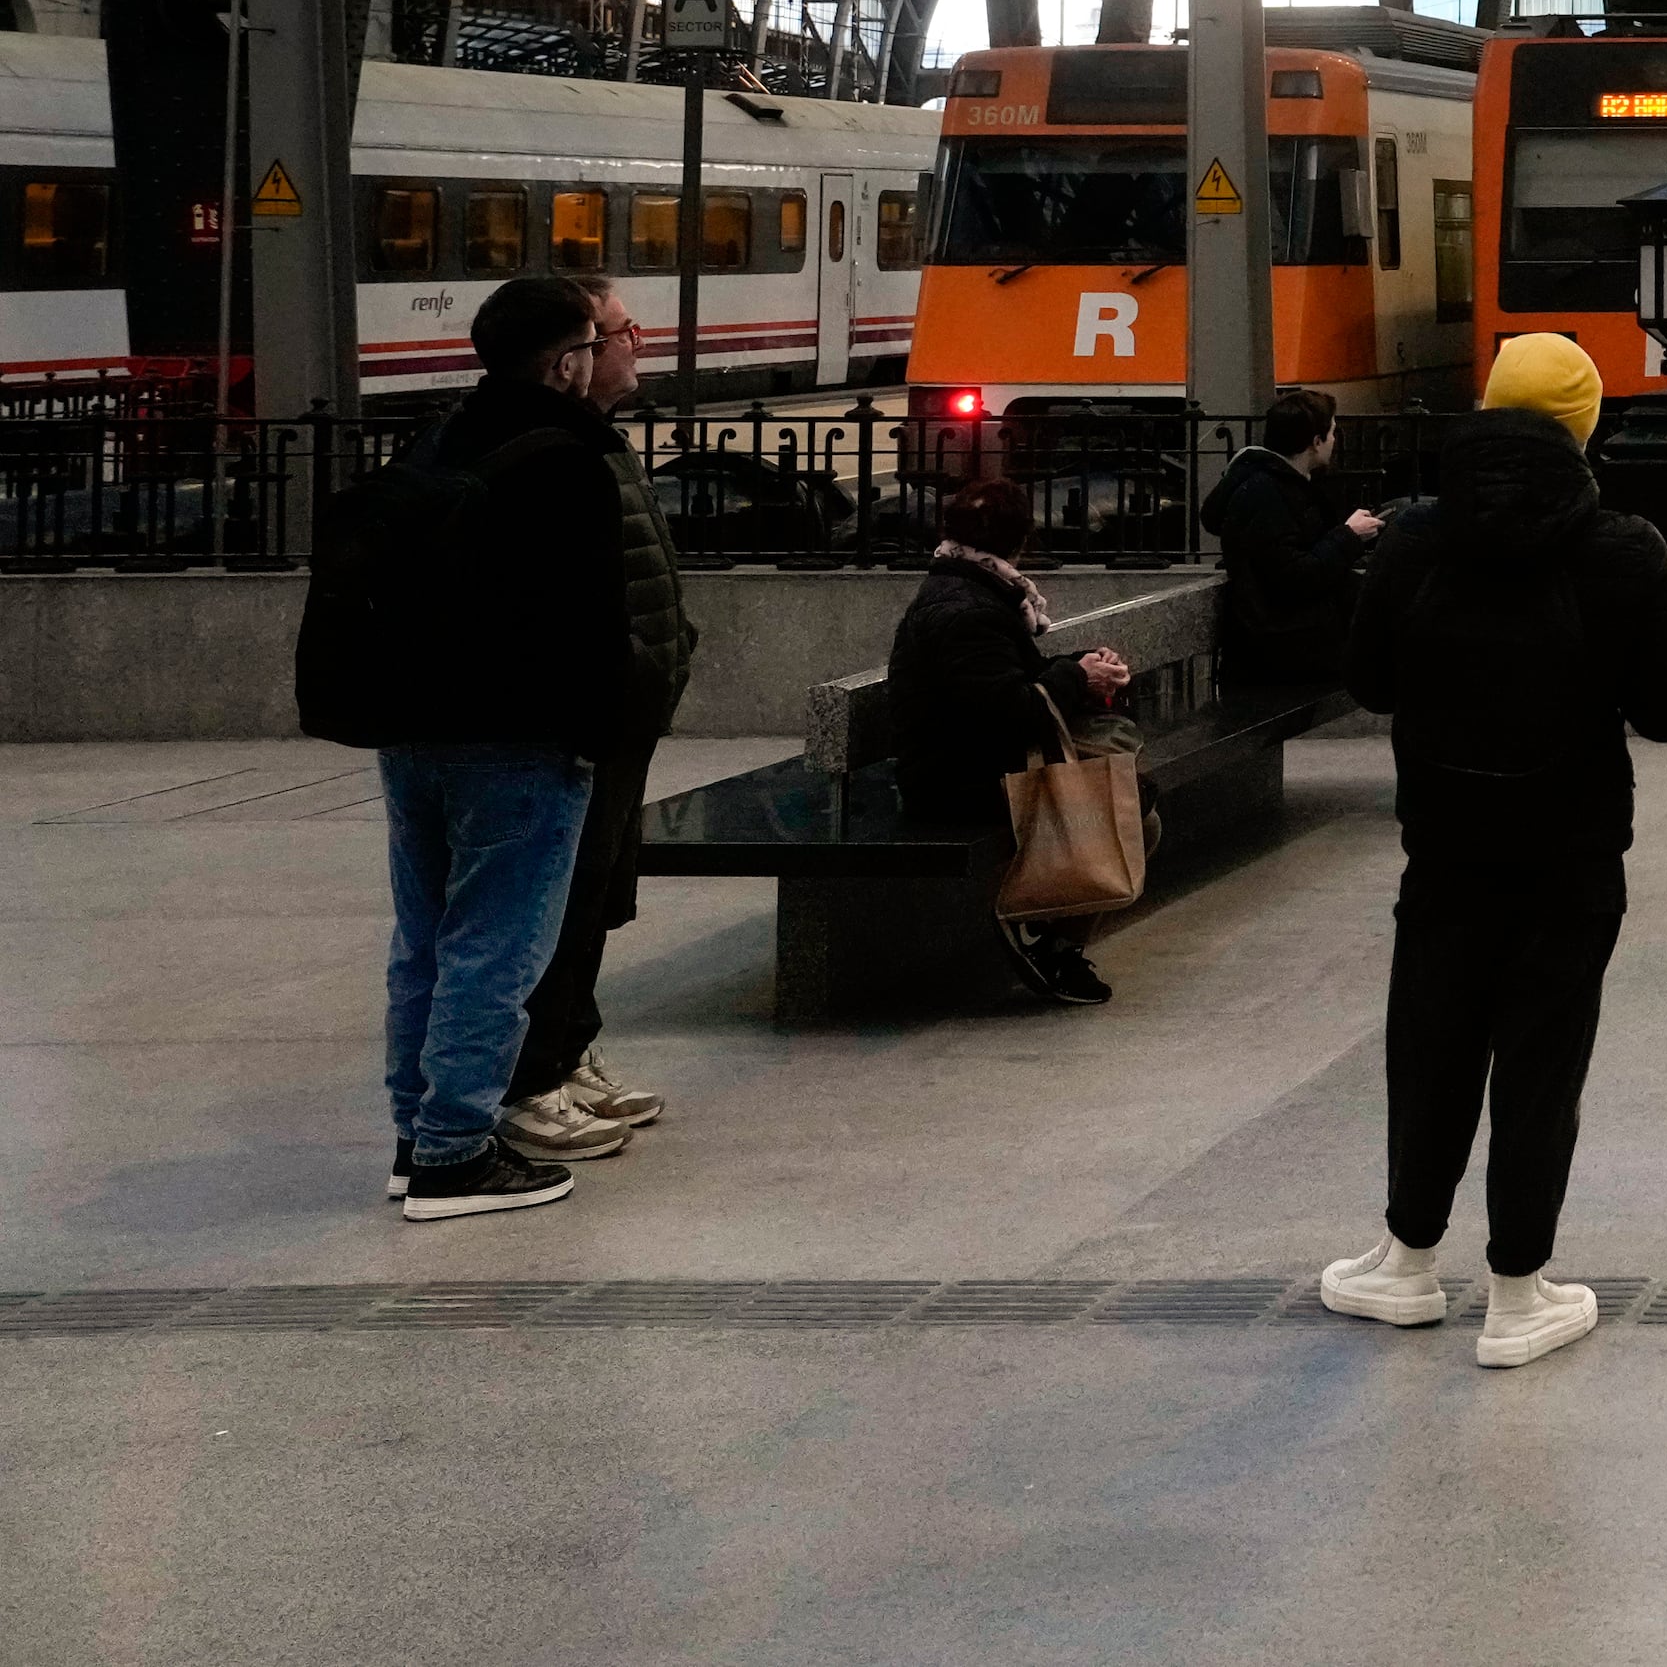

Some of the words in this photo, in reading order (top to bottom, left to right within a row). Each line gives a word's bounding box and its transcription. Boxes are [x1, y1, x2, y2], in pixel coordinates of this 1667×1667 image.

[668, 21, 723, 32] SECTOR
[967, 104, 1041, 126] 360M
[1601, 94, 1630, 117] R2
[411, 288, 454, 318] renfe
[1073, 292, 1139, 356] R
